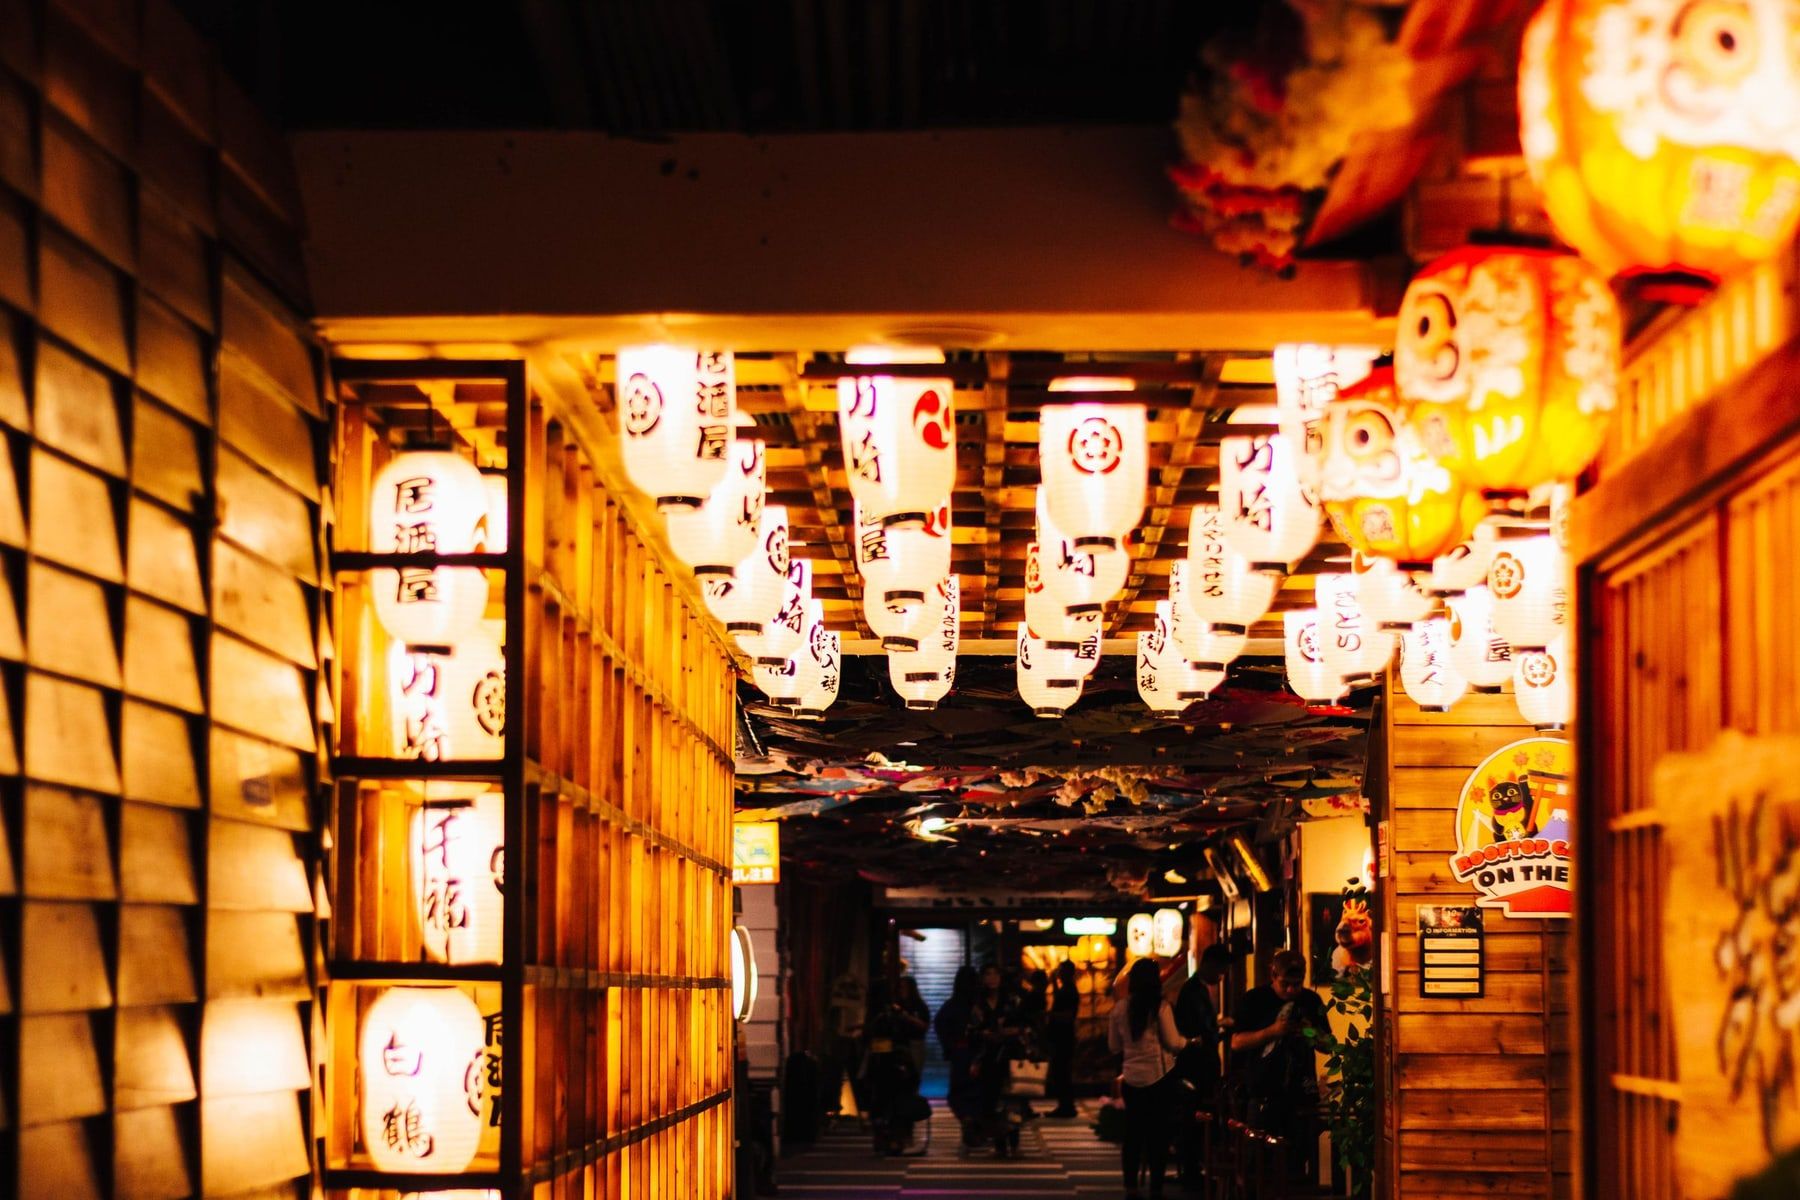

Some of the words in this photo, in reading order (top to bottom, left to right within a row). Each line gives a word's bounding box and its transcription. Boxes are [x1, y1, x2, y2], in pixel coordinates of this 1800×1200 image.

[394, 476, 442, 603] 居酒屋
[422, 812, 470, 931] 千福
[1455, 839, 1550, 874] ROOFTOP
[1478, 867, 1515, 888] ON
[1520, 865, 1569, 882] THE
[382, 1030, 434, 1159] 白鶴
